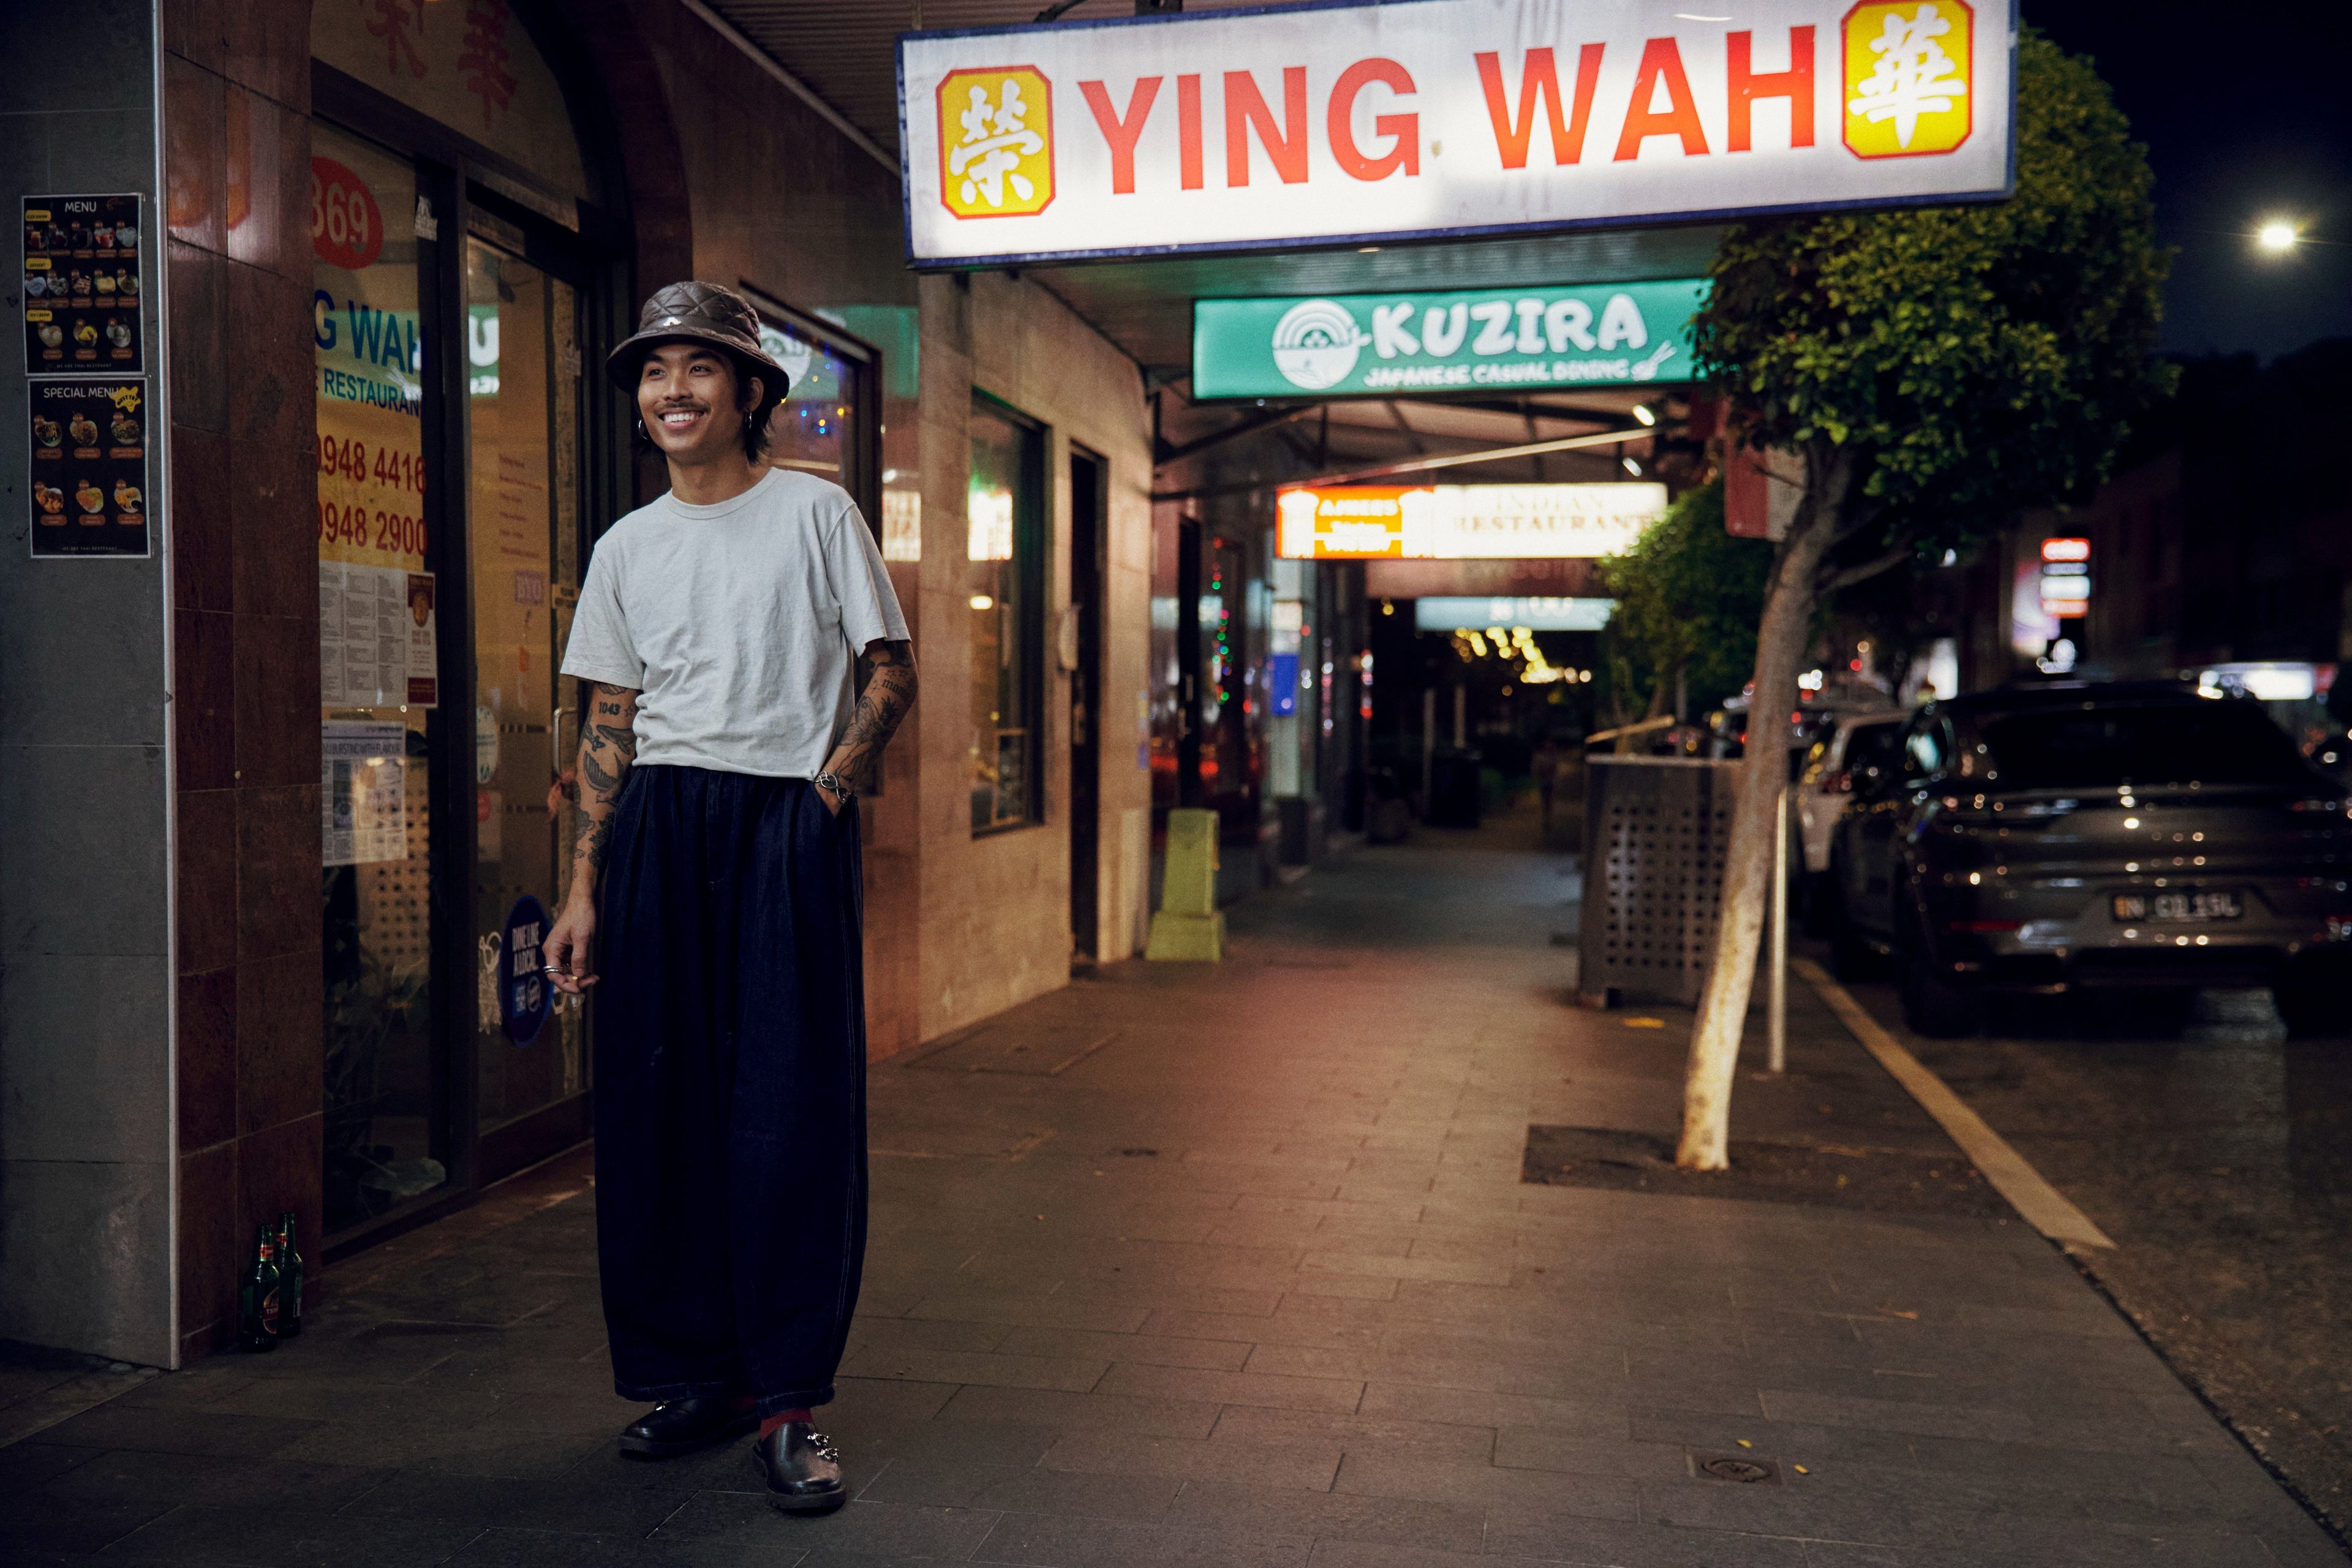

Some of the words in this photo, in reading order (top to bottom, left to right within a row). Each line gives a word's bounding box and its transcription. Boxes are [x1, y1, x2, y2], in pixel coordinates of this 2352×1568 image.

[1847, 3, 1968, 149] 華
[1077, 57, 1420, 195] YING
[1474, 24, 1817, 170] WAH
[949, 78, 1044, 208] 榮
[65, 202, 97, 213] MENU
[1371, 293, 1649, 360] KUZIRA
[43, 387, 86, 398] SPECIAL
[88, 387, 118, 398] MENU
[324, 368, 427, 418] RESTAURAN
[1363, 364, 1472, 388] JAPANESE
[1472, 361, 1551, 383] CASUAL
[1551, 358, 1630, 380] DINING
[374, 447, 426, 495] 4416
[375, 511, 428, 556] 2900
[598, 701, 621, 716] 1043
